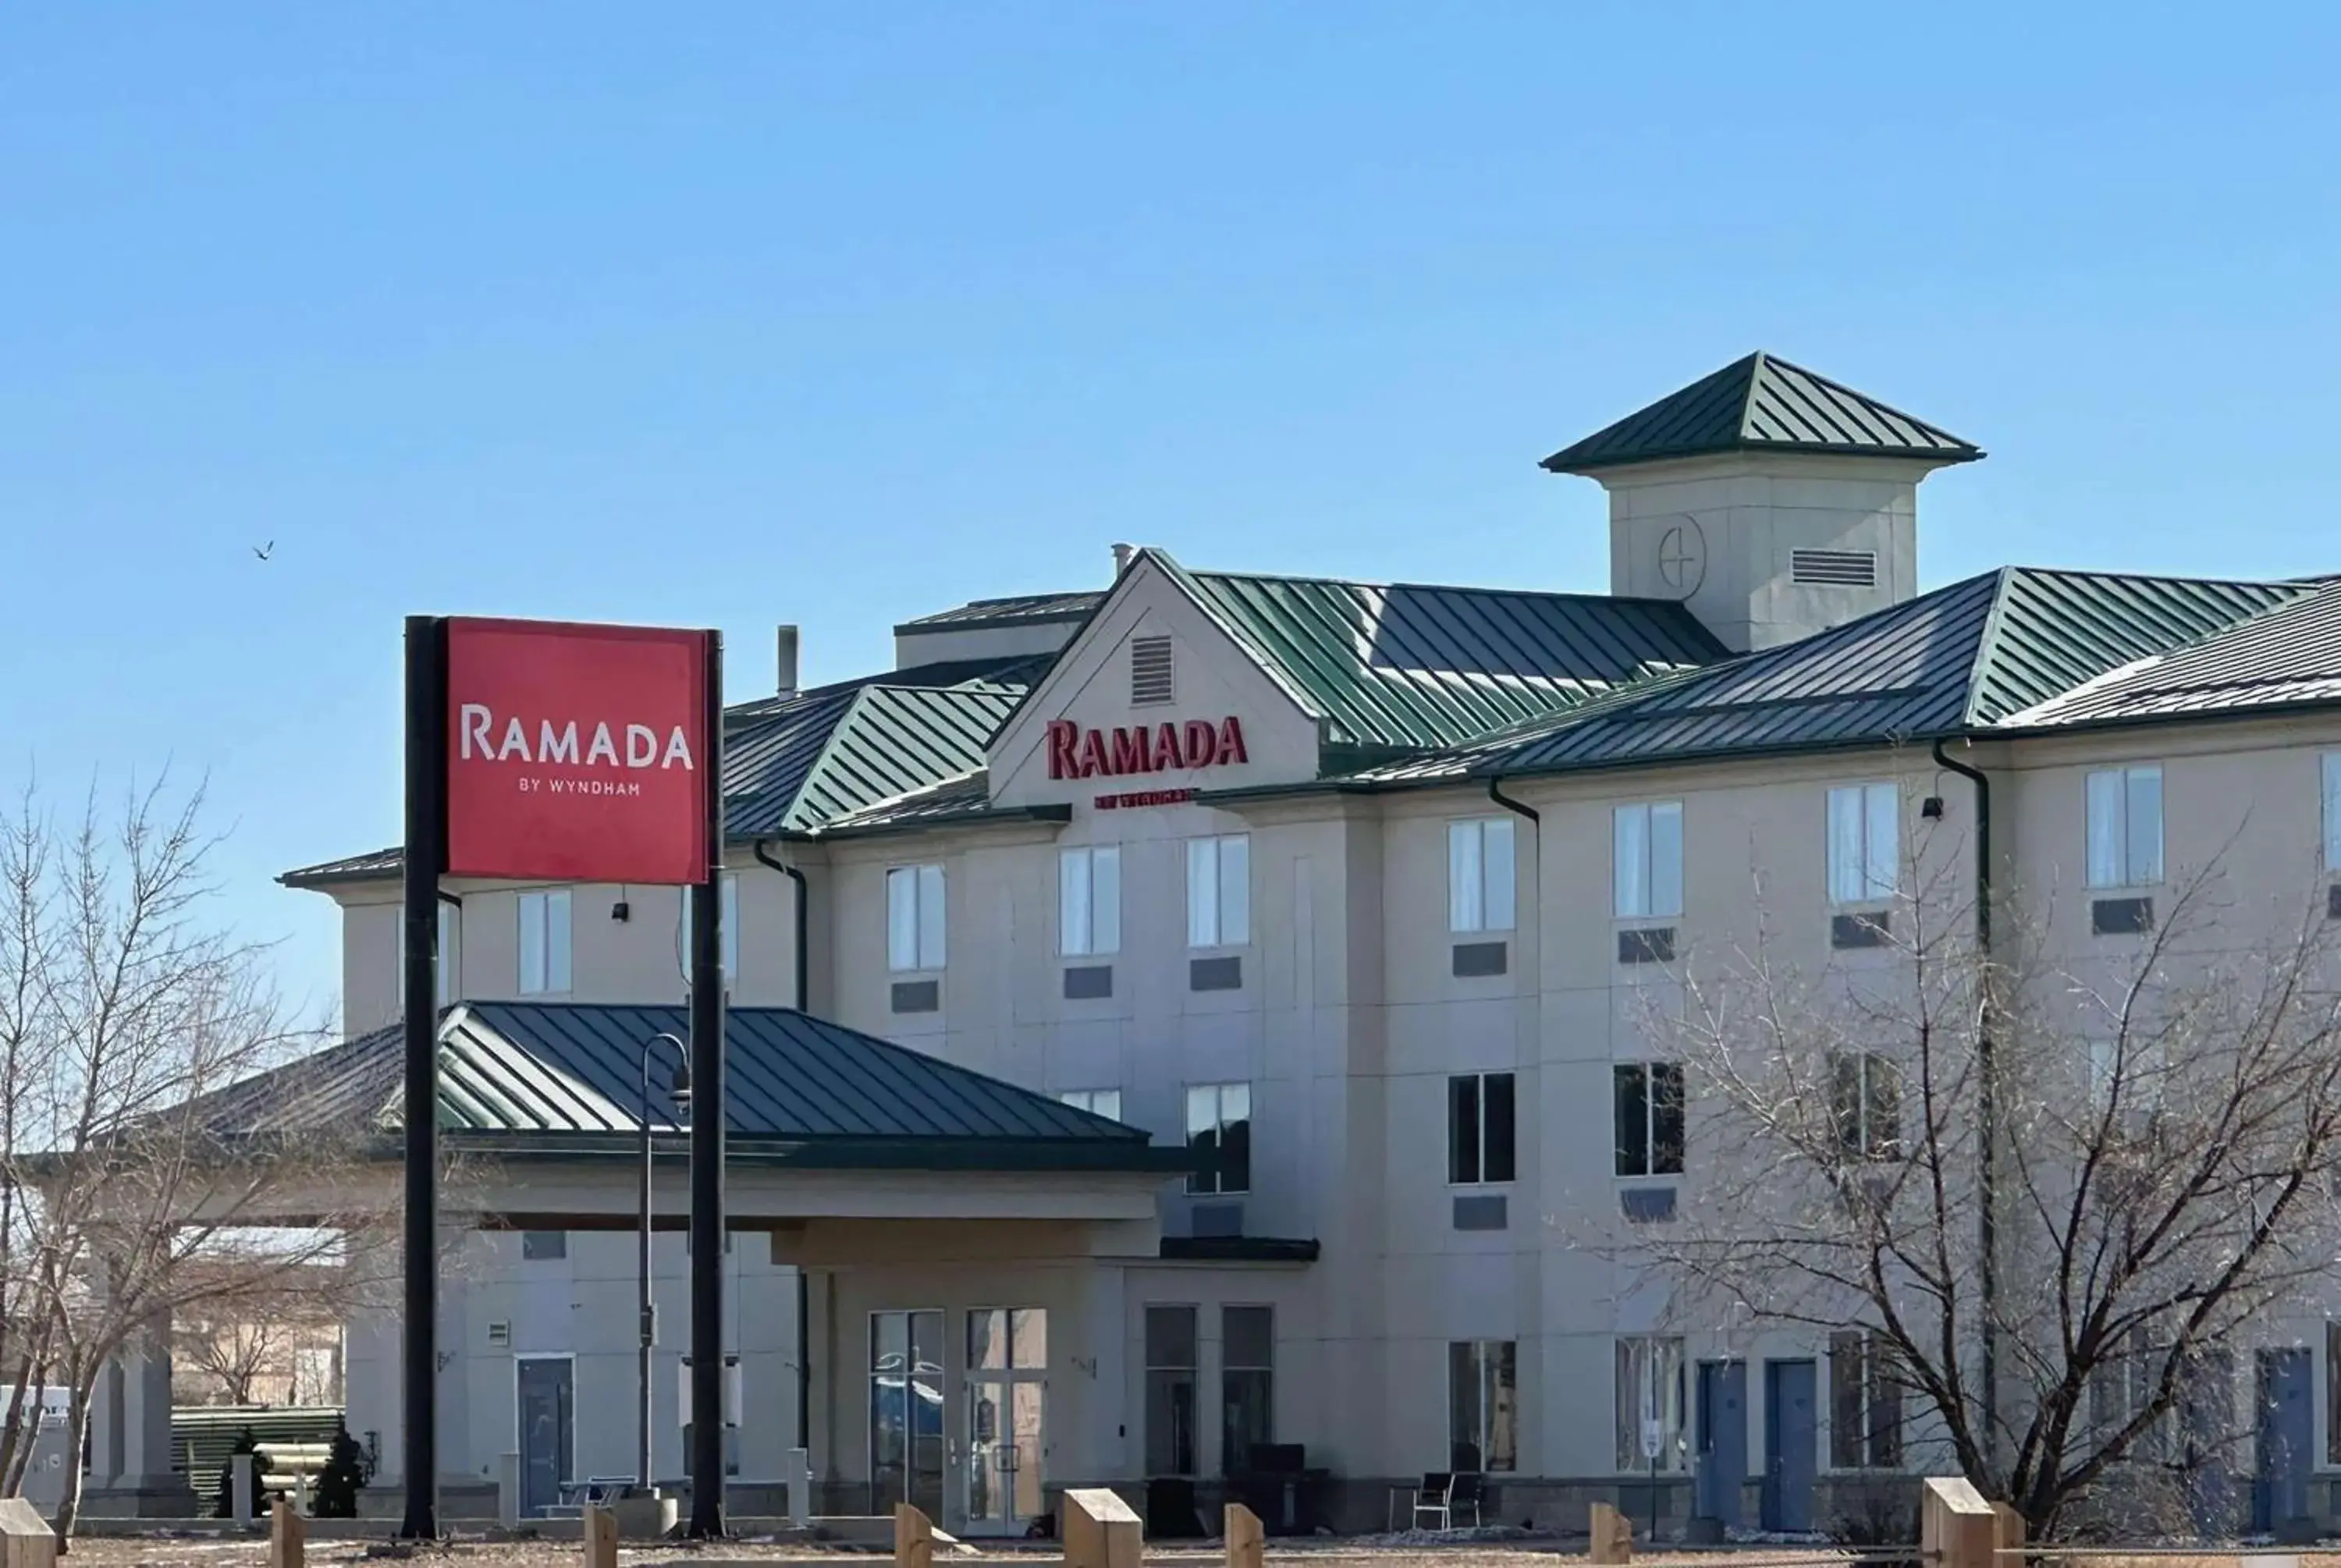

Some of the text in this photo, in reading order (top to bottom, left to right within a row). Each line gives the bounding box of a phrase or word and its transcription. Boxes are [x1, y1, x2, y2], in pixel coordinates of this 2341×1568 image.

[461, 704, 694, 770] RAMADA
[1047, 716, 1249, 779] RAMADA
[519, 778, 640, 796] BY WYNDHAM
